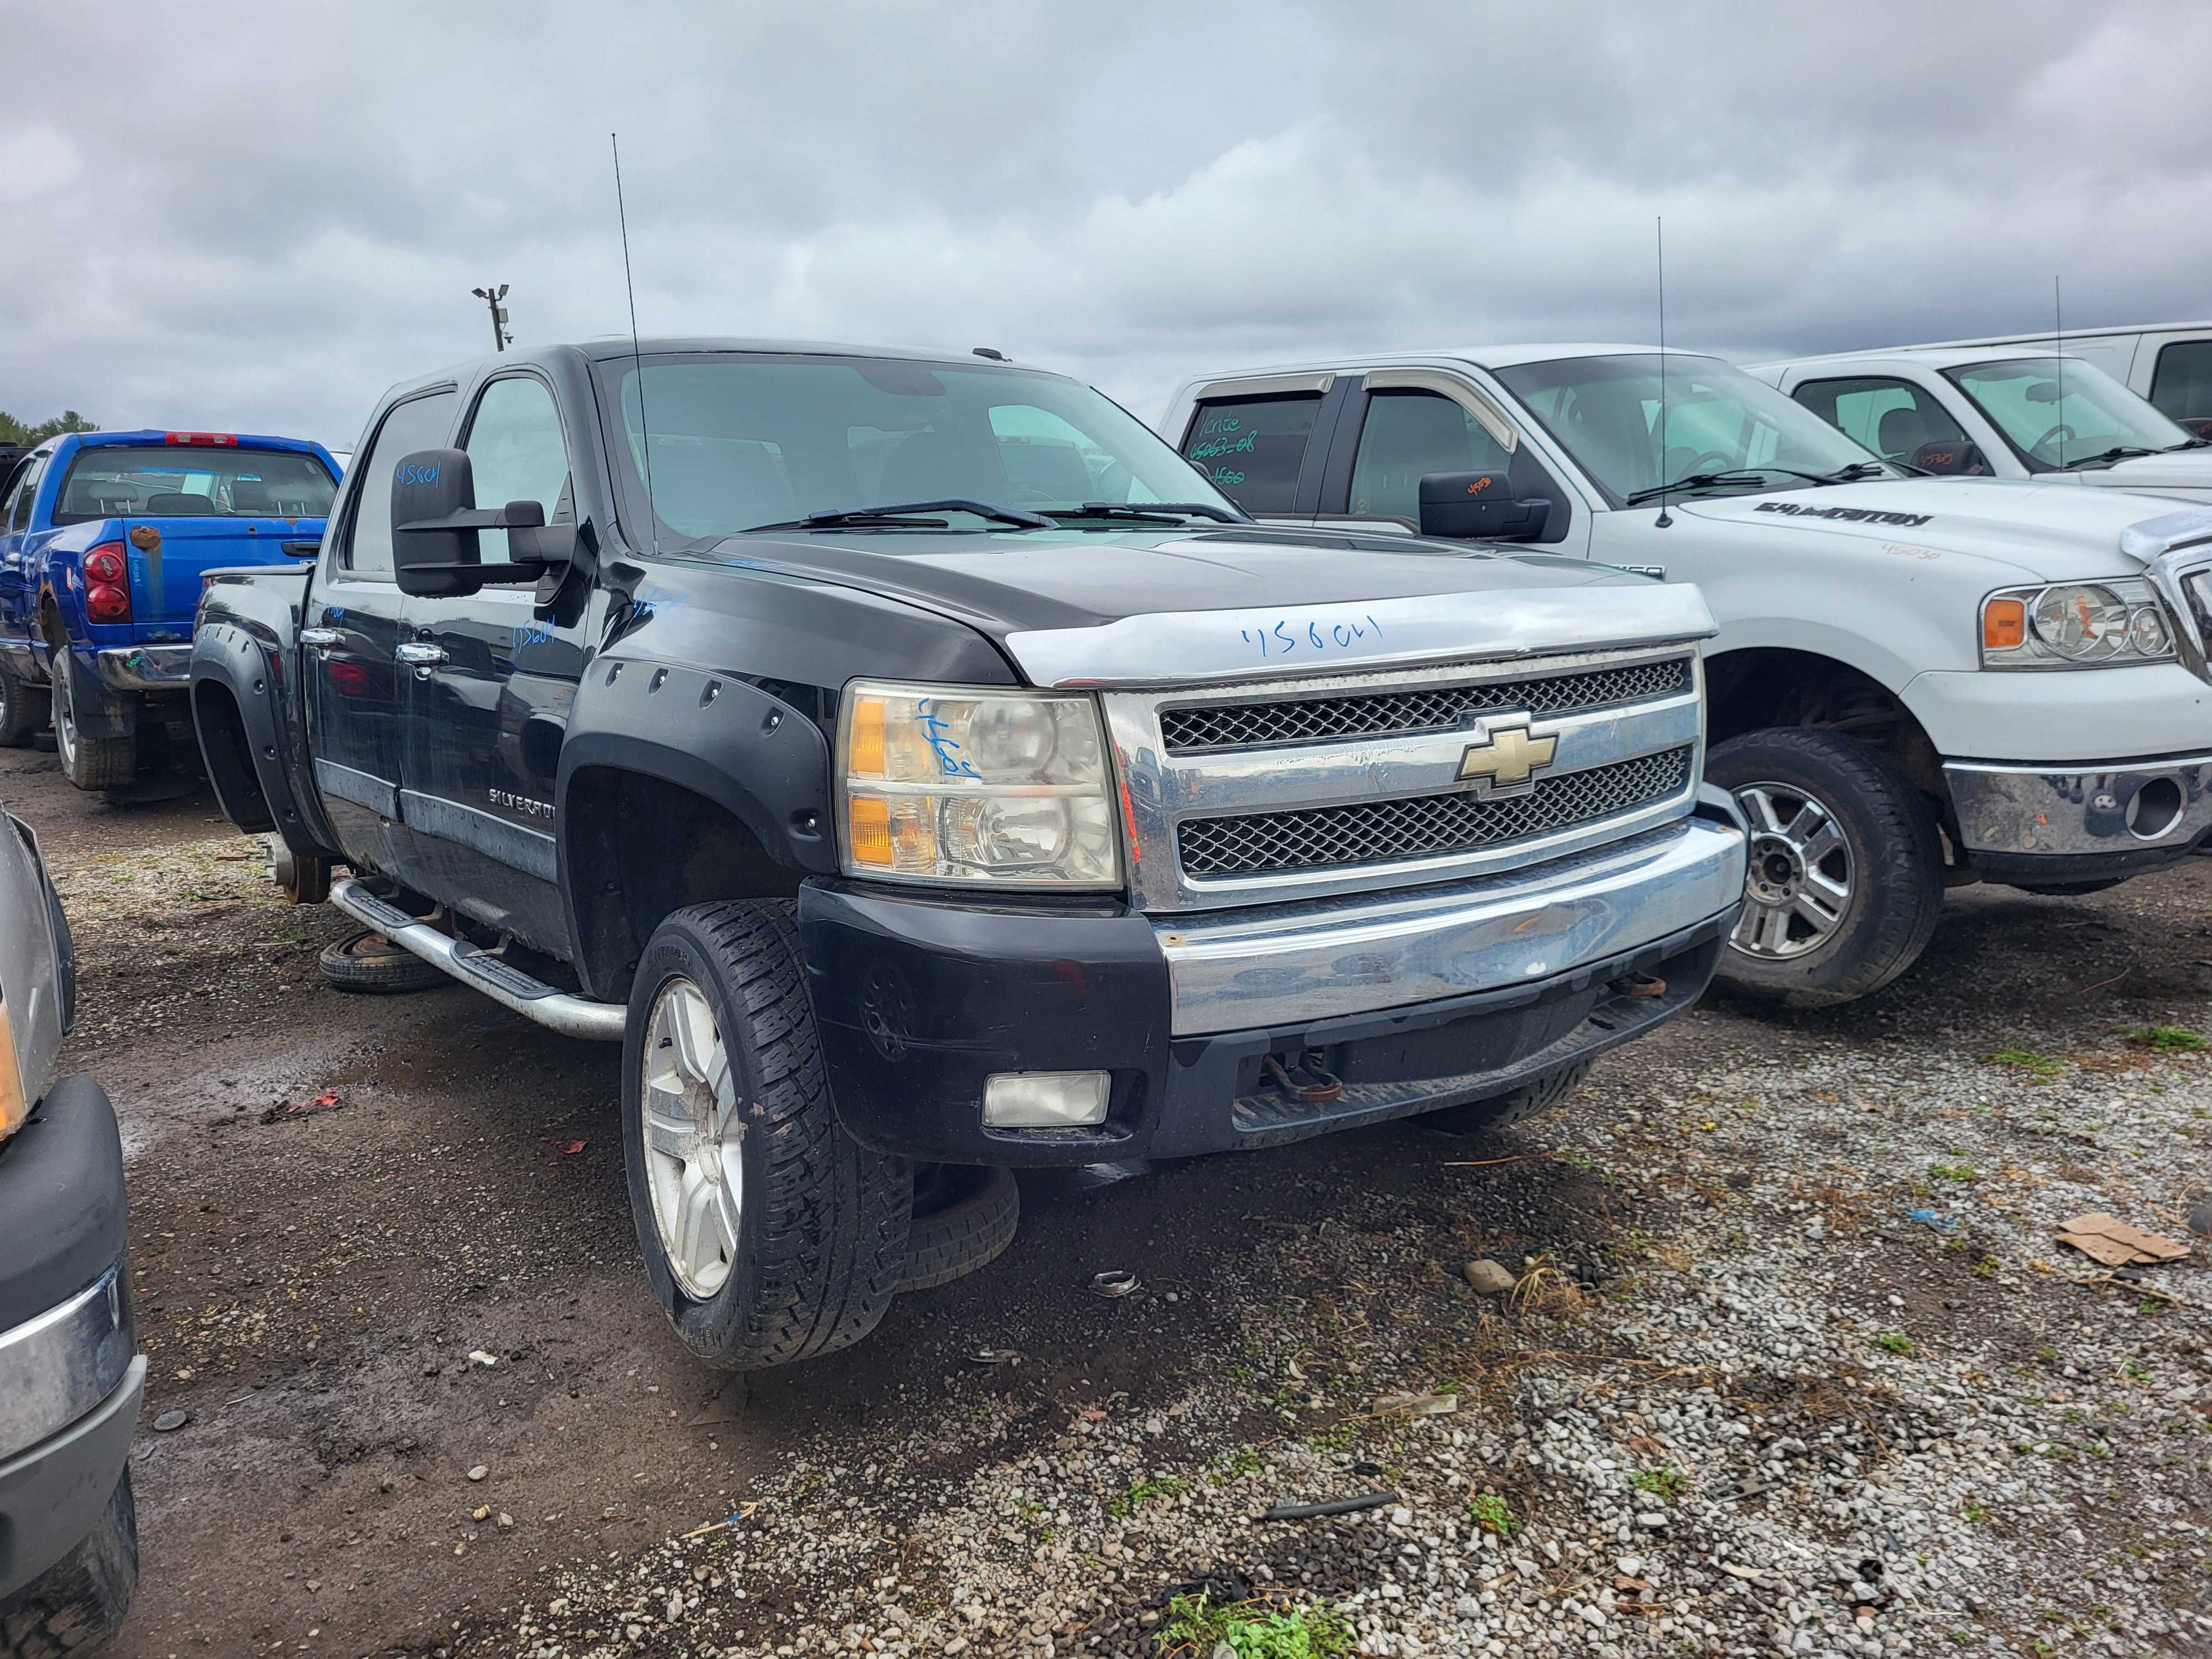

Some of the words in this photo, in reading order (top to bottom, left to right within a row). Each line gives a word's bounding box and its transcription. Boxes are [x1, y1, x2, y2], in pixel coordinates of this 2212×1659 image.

[397, 460, 441, 488] 45604
[1241, 614, 1383, 657] 45604
[489, 789, 556, 820] SILVERAD
